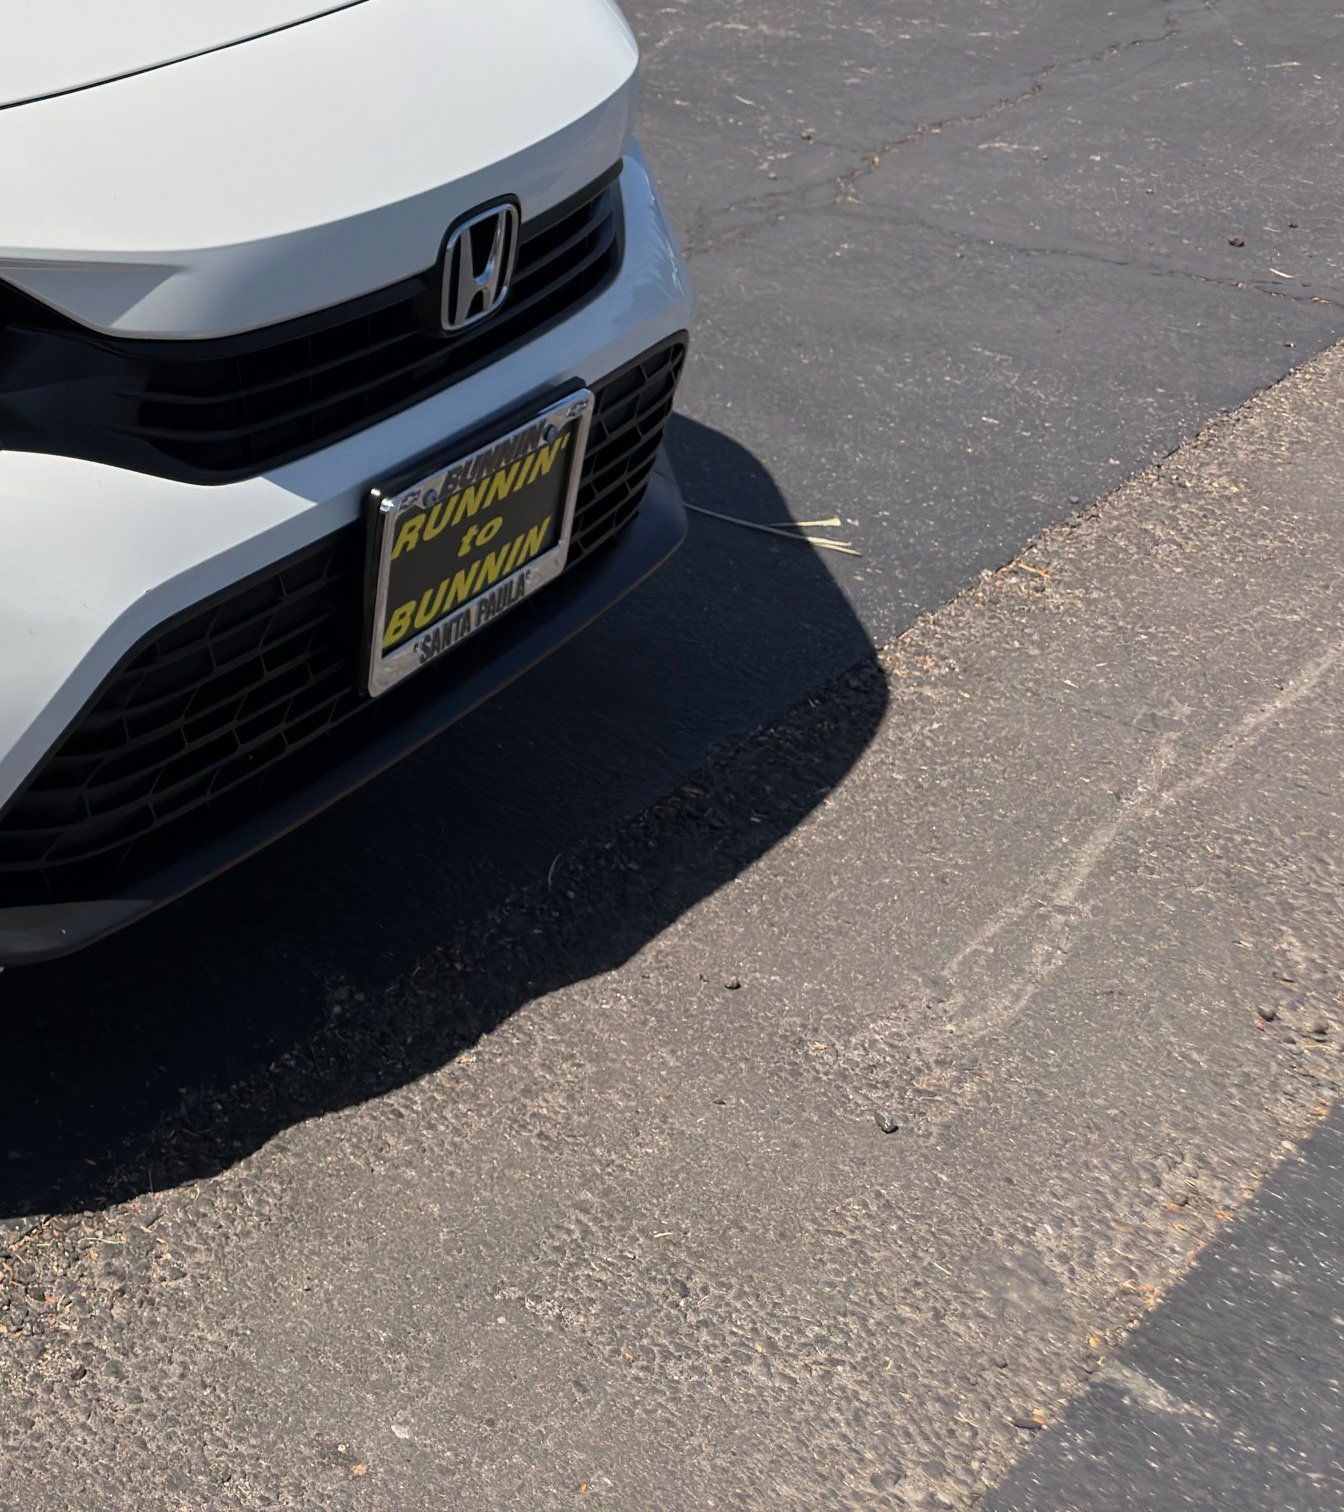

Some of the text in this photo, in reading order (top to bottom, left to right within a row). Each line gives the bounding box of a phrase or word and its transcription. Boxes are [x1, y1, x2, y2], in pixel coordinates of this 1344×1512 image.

[390, 432, 571, 561] RUNNIN'
[457, 516, 504, 558] to
[382, 515, 552, 648] BUNNIN
